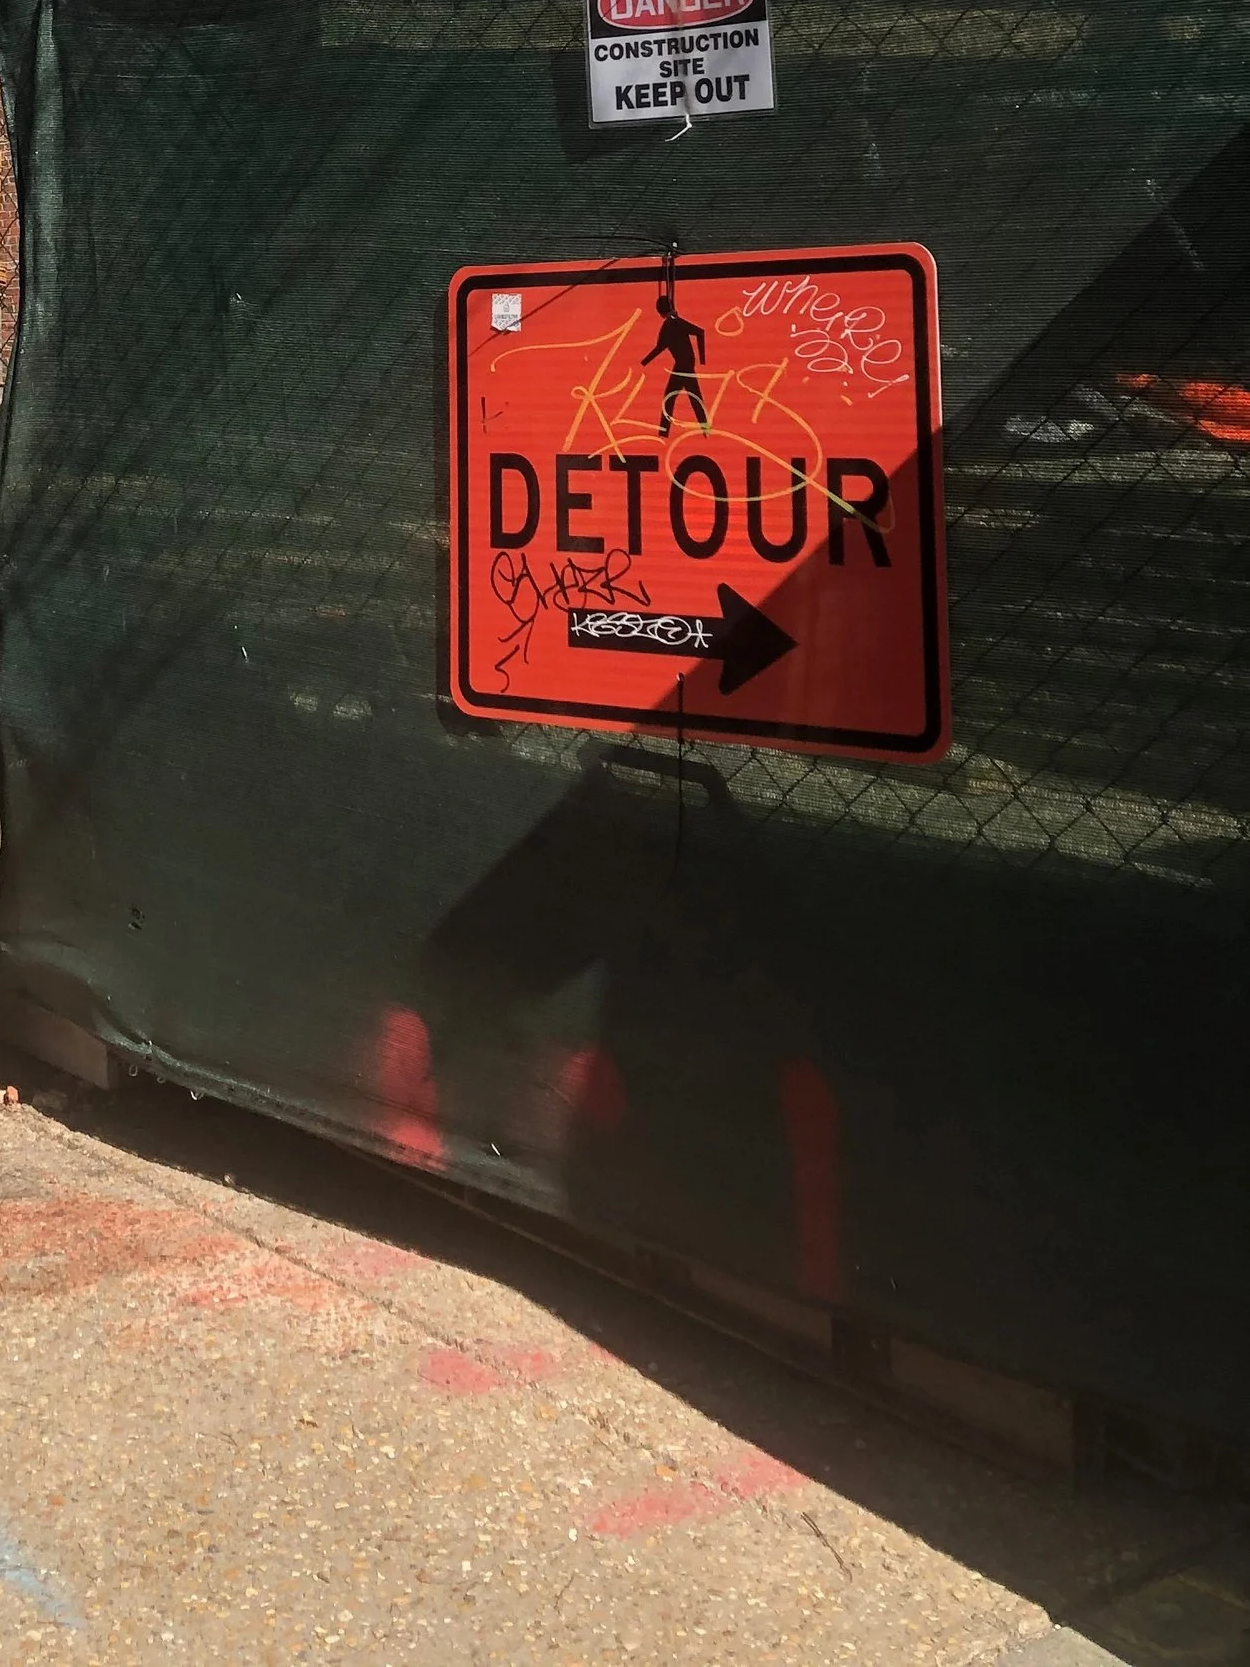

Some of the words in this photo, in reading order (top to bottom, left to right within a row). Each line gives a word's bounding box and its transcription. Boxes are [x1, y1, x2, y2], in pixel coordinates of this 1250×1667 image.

[594, 28, 760, 62] CONSTRUCTION
[659, 57, 705, 78] SITE
[615, 81, 687, 111] KEEP
[694, 74, 751, 104] OUT
[489, 452, 893, 569] DETOUR
